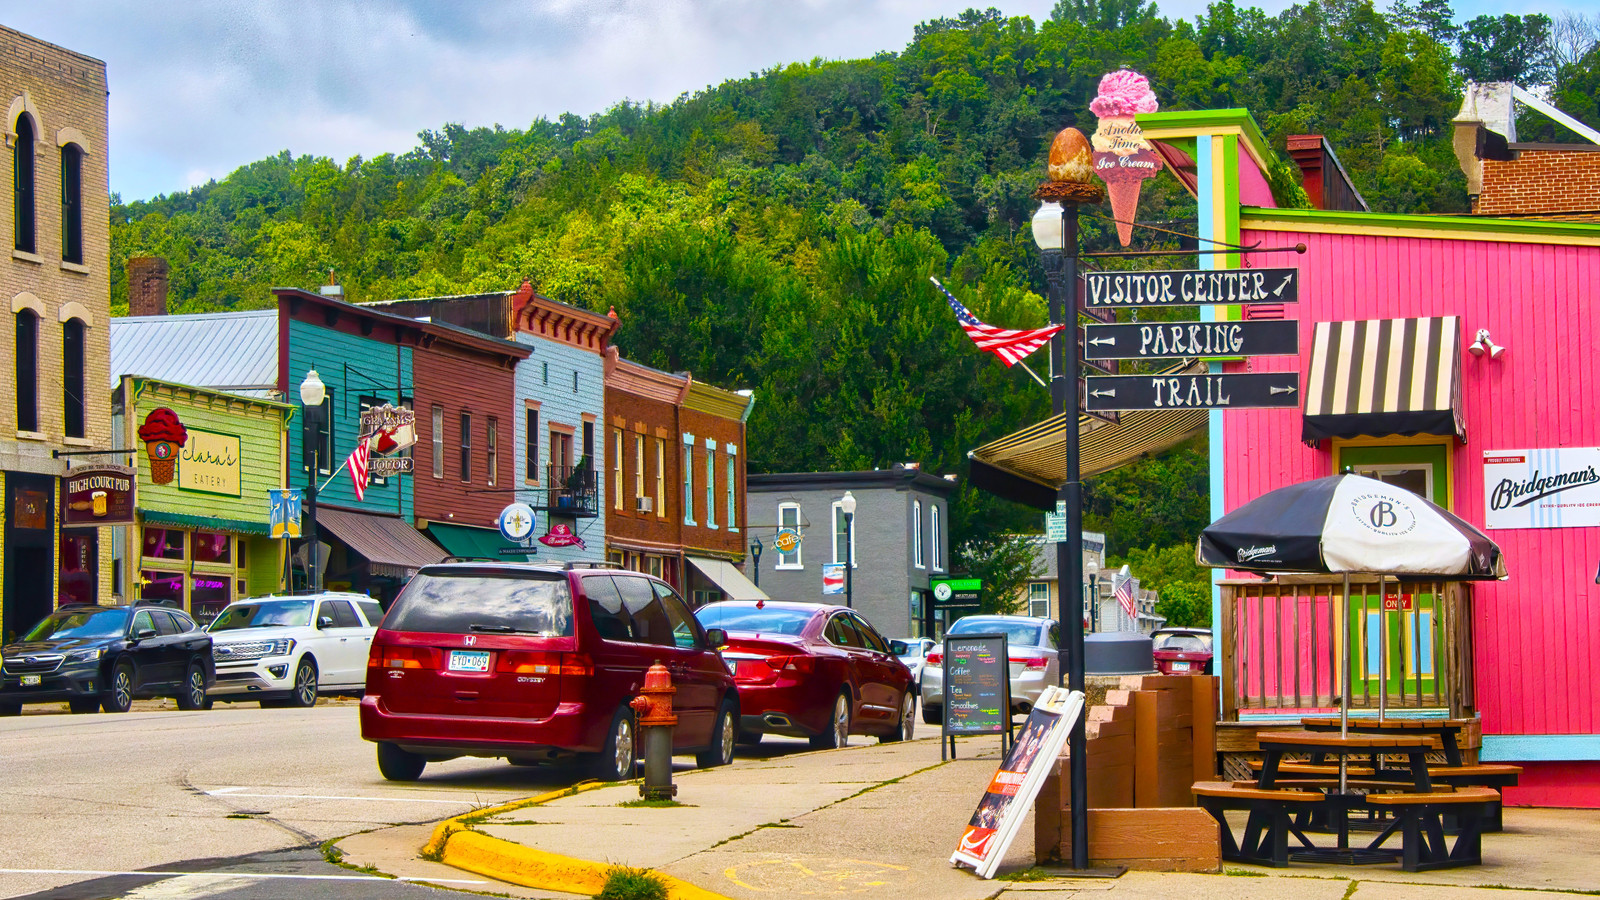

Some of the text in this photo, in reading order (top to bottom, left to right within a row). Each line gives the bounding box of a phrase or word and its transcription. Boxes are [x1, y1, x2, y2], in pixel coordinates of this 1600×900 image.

[1100, 122, 1144, 138] Anothe
[1109, 136, 1140, 149] Time
[1096, 156, 1154, 170] Ice Cream
[1089, 272, 1269, 304] VISITOR CENTER
[1139, 324, 1244, 355] PARKING
[1152, 376, 1231, 407] TRAIL
[183, 436, 237, 466] clara's
[368, 460, 408, 471] LIQUOR
[69, 476, 130, 494] HIGH COURT PUB
[194, 473, 226, 487] EATERY
[1490, 465, 1600, 511] Bridgeman's
[775, 535, 799, 548] cafe
[1237, 545, 1277, 562] Bridgeman's
[1386, 600, 1407, 608] ONY
[950, 642, 988, 652] Lemonade
[950, 666, 971, 675] Coffee
[950, 685, 963, 694] Tea
[949, 717, 964, 728] Soda
